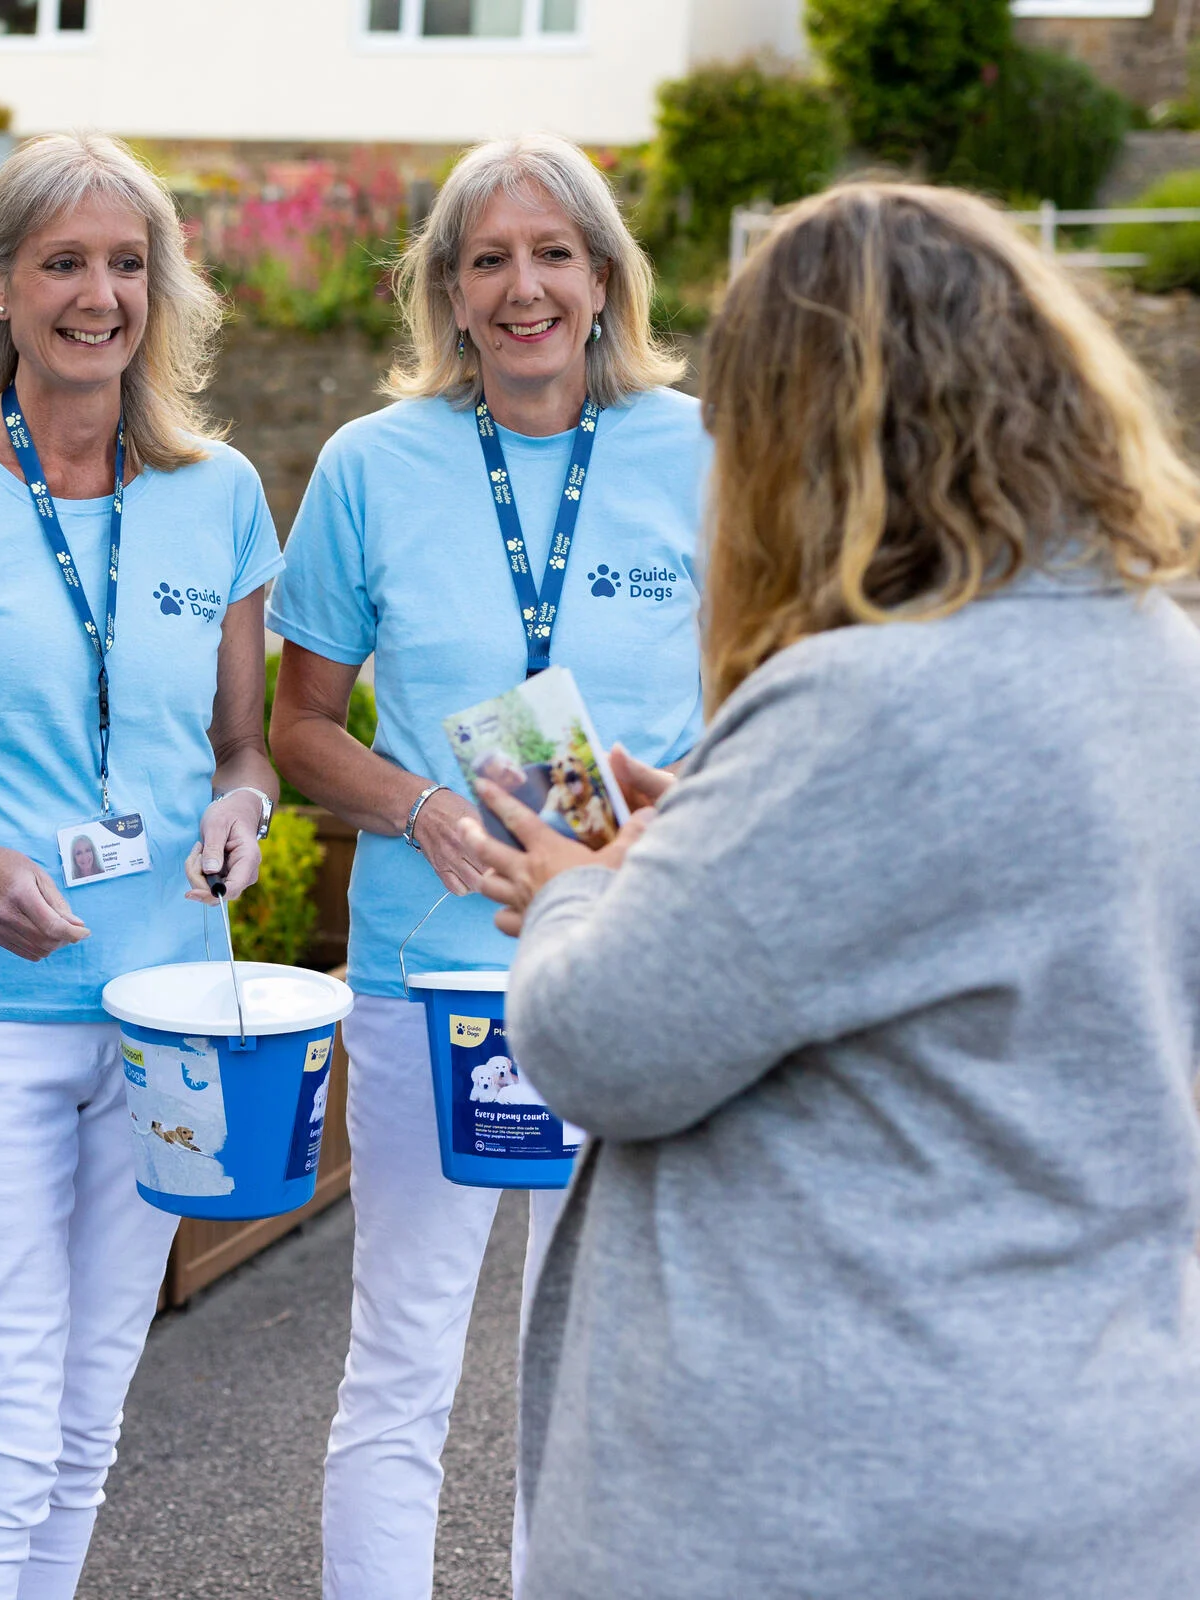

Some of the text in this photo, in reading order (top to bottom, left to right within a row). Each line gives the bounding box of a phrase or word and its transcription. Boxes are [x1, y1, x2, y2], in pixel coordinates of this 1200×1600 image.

[479, 420, 487, 437] Dogs
[484, 416, 495, 437] Guide
[10, 430, 21, 449] Dogs
[18, 427, 29, 449] Guide
[568, 463, 579, 485] Guide
[575, 467, 585, 486] Dogs
[495, 486, 503, 504] Dogs
[501, 484, 512, 505] Guide
[36, 498, 46, 517] Dogs
[42, 497, 54, 518] Guide
[553, 532, 564, 553] Guide
[560, 536, 570, 555] Dogs
[510, 555, 520, 573] Dogs
[518, 553, 528, 574] Guide
[62, 568, 73, 586] Dogs
[67, 567, 79, 588] Guide
[628, 567, 677, 582] Guide
[186, 587, 221, 606] Guide
[630, 585, 673, 601] Dogs
[539, 602, 548, 622] Guide
[546, 605, 556, 622] Dogs
[475, 1108, 550, 1123] Every penny counts
